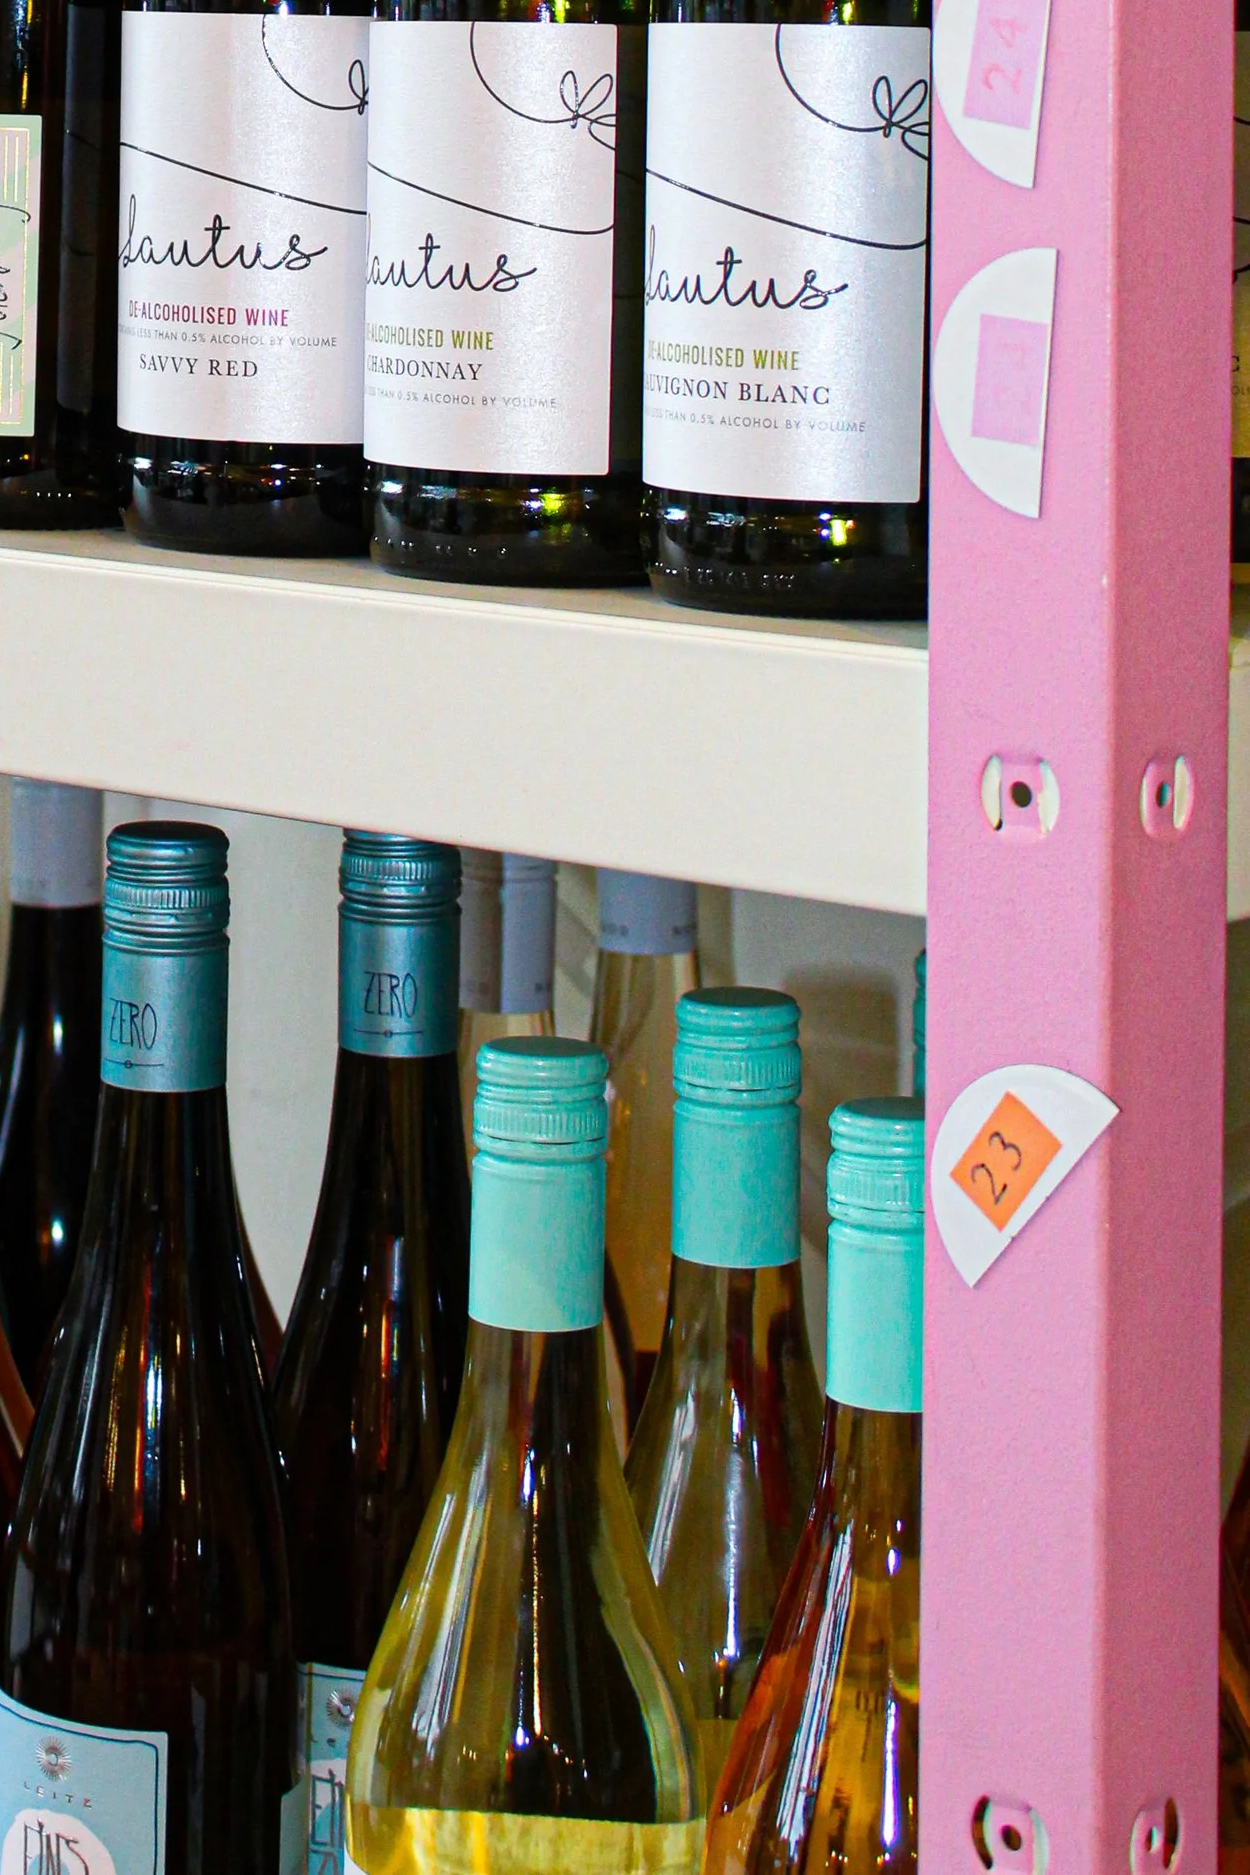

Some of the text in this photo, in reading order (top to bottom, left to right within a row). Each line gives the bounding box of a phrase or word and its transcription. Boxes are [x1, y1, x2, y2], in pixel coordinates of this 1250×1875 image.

[981, 17, 1029, 96] 24
[129, 300, 289, 327] DE-ALCOHOLISED WINE
[154, 329, 178, 341] THAN
[181, 332, 206, 343] 0.5%
[210, 333, 264, 346] ALCOHOL
[290, 336, 337, 347] VOLUME
[366, 322, 494, 351] E-ALCOHOLISED WINE
[139, 353, 258, 377] SAVVY RED
[753, 349, 800, 370] WINE
[397, 390, 419, 402] 0.5%
[423, 393, 475, 405] ALCOHOL
[482, 396, 496, 406] BY
[738, 382, 830, 405] BLANC
[665, 409, 686, 422] THAN
[690, 413, 715, 425] 0.5%
[720, 415, 778, 429] ALCOHOL
[786, 419, 800, 430] BY
[808, 420, 866, 432] VOLUME
[363, 970, 418, 1019] ZERO
[108, 997, 158, 1051] ZERO
[971, 1130, 1022, 1205] 23
[23, 1781, 92, 1808] LEITZ
